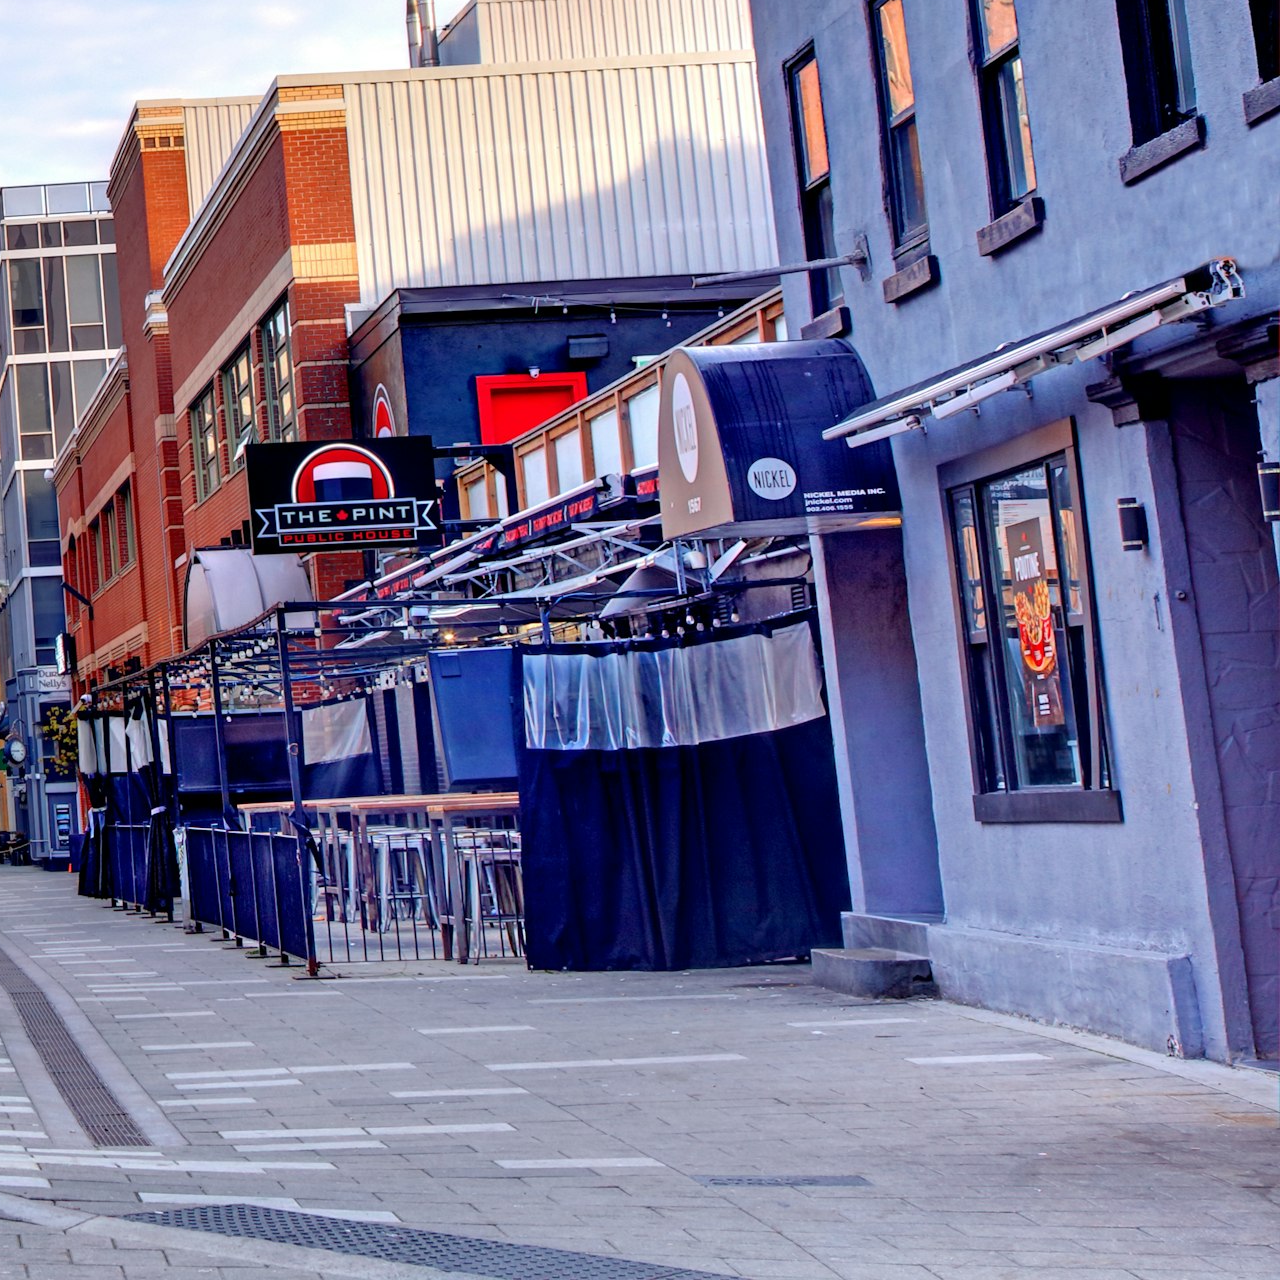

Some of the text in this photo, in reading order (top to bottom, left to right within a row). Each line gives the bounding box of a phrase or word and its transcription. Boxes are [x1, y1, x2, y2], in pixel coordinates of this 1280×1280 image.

[753, 469, 791, 489] NICKEL
[805, 496, 853, 507] jnickel.com
[806, 504, 854, 513] 902.406.1555
[282, 506, 410, 524] THE PINT
[283, 529, 413, 544] PUBLIC HOUSE
[38, 669, 66, 680] Dur
[38, 680, 67, 689] Nelly's
